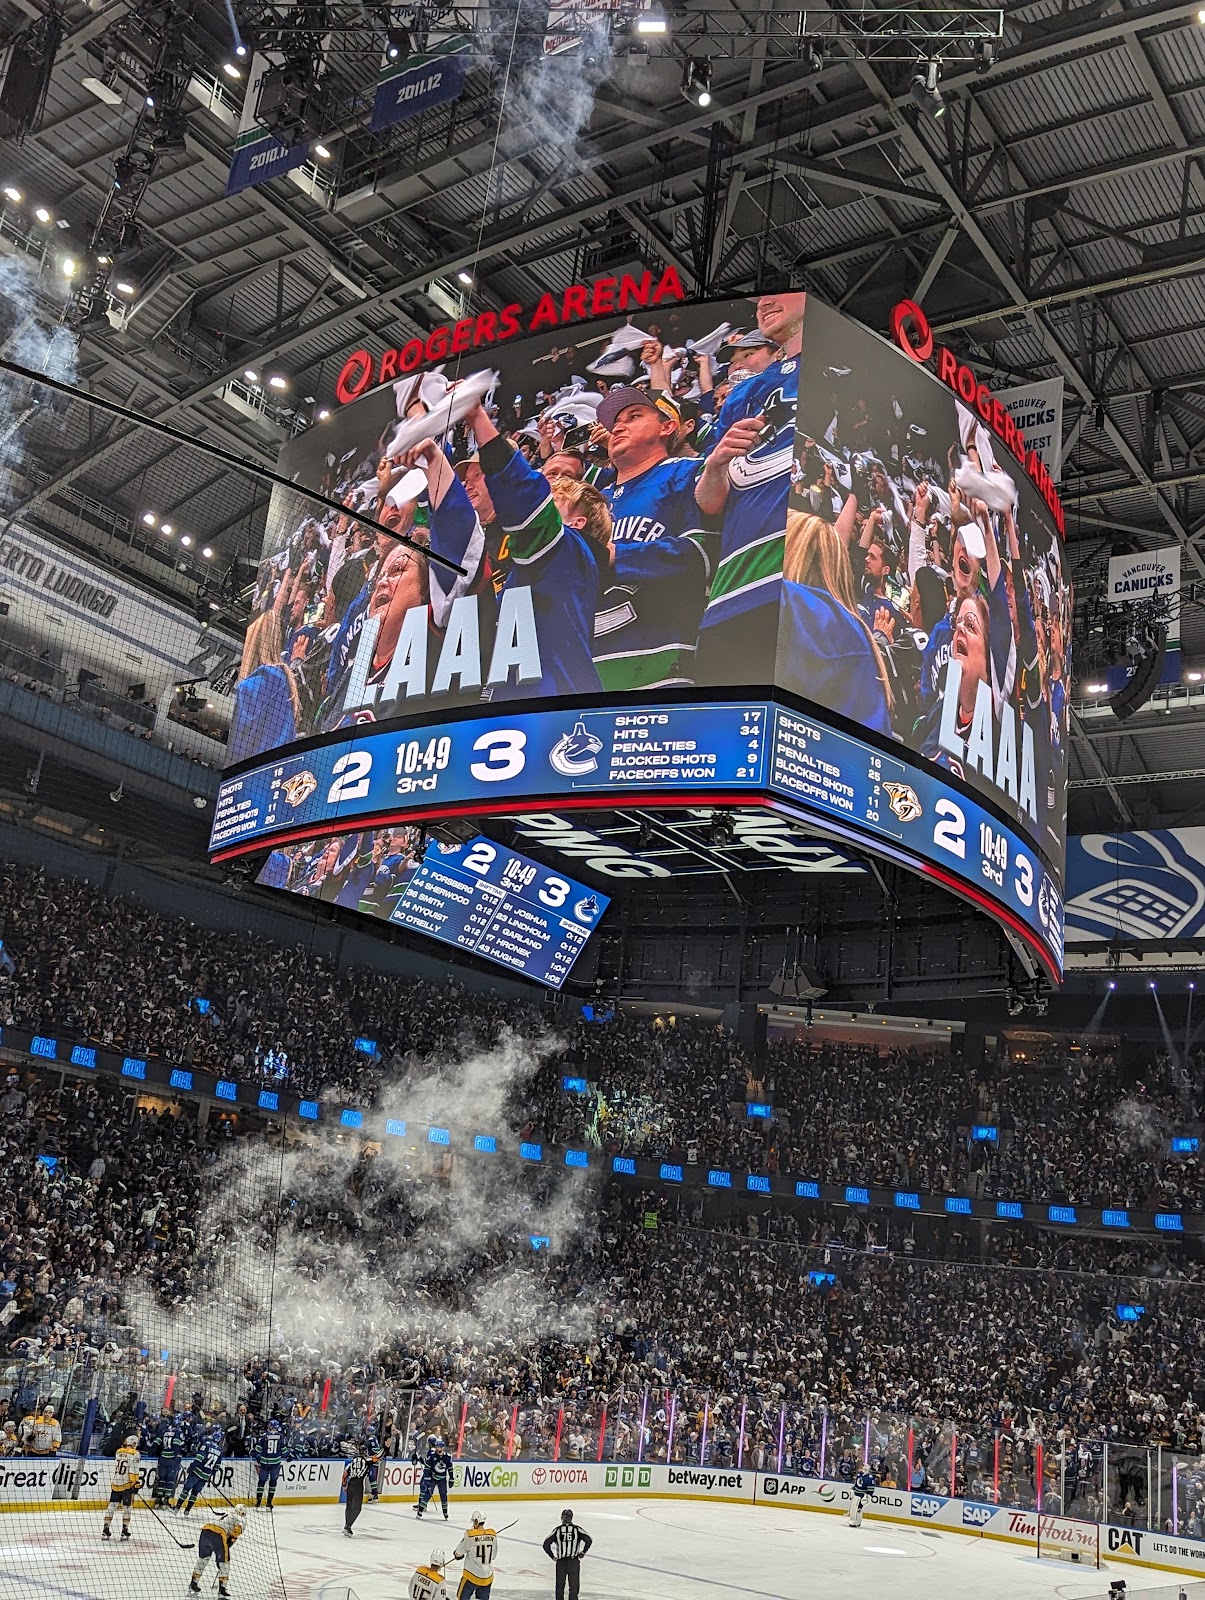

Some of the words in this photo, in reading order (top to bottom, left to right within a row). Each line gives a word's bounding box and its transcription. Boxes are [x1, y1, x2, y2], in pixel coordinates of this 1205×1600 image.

[396, 73, 442, 104] 2011.12
[379, 303, 522, 384] ROGERS
[529, 266, 685, 331] ARENA
[937, 347, 1026, 464] ROGERS
[1003, 399, 1046, 413] NCOUVER
[1012, 409, 1055, 429] UCKS
[612, 516, 665, 542] UVER
[1122, 564, 1166, 579] VANCOUVER
[43, 566, 118, 618] LUONGO
[1115, 573, 1173, 594] CANUCKS
[615, 714, 669, 726] SHOTS
[742, 712, 761, 722] 17
[614, 728, 648, 739] HITS
[740, 725, 760, 736] 34
[779, 716, 821, 741] SHOTS
[870, 756, 881, 768] 16
[938, 656, 1038, 824] LAAA
[612, 740, 696, 753] PENALTIES
[748, 739, 759, 750] 4
[778, 730, 806, 749] HITS
[868, 769, 881, 782] 25
[327, 751, 372, 804] 2
[396, 736, 451, 775] 10:49
[470, 730, 527, 781] 3
[610, 754, 670, 767] BLOCKED
[671, 753, 716, 765] SHOTS
[747, 753, 757, 764] 9
[777, 743, 840, 778] PENALTIES
[873, 784, 880, 795] 2
[220, 782, 243, 797] SHOTS
[274, 768, 284, 777] 16
[397, 774, 438, 794] 3rd
[609, 768, 679, 780] FACEOFFS
[680, 767, 715, 779] WON
[736, 767, 755, 778] 21
[776, 757, 821, 784] BLOCKED
[822, 776, 854, 798] SHOTS
[868, 796, 879, 808] 11
[219, 796, 234, 808] HITS
[271, 779, 281, 789] 25
[774, 772, 829, 801] FACEOFFS
[830, 792, 854, 812] WON
[866, 810, 879, 822] 20
[217, 800, 251, 819] PENALTIES
[273, 791, 279, 800] 2
[215, 814, 239, 831] BLOCKED
[239, 808, 259, 821] SHOTS
[268, 803, 277, 812] 11
[213, 824, 241, 842] FACEOFFS
[241, 820, 257, 831] WON
[265, 815, 276, 824] 20
[934, 798, 966, 860] 2
[979, 822, 1008, 870] 10:49
[1015, 854, 1033, 907] 3
[462, 842, 497, 875] 2
[502, 858, 537, 886] 10:49
[538, 877, 571, 907] 3
[981, 860, 1003, 887] 3rd
[421, 868, 428, 876] 9
[430, 871, 474, 895] FORSBERG
[482, 892, 500, 905] 0:12
[500, 876, 524, 894] 3rd
[413, 878, 424, 887] 44
[425, 882, 470, 906] SHERWOOD
[476, 903, 493, 915] 0:12
[401, 900, 410, 909] 14
[411, 904, 448, 923] NYQUIST
[463, 924, 481, 936] 0:12
[406, 889, 418, 898] 36
[419, 893, 445, 908] SMITH
[469, 913, 487, 926] 0:12
[394, 910, 405, 919] 90
[406, 914, 442, 933] O'REILLY
[457, 934, 475, 946] 0:12
[495, 912, 507, 922] 23
[508, 916, 551, 942] LINDHOLM
[560, 941, 578, 954] 0:12
[502, 901, 513, 910] 81
[513, 906, 548, 928] JOSHUA
[566, 932, 583, 944] 0:12
[485, 933, 494, 942] 17
[495, 938, 532, 958] HRONEK
[550, 962, 567, 975] 1:04
[492, 923, 499, 931] 8
[502, 928, 543, 950] GARLAND
[554, 952, 572, 964] 0:12
[478, 943, 490, 953] 43
[490, 948, 526, 969] HUGHES
[544, 972, 561, 984] 1:05
[31, 1037, 56, 1058] GOAL
[71, 1046, 95, 1067] GOAL
[122, 1058, 145, 1079] GOAL
[170, 1070, 192, 1089] GOAL
[216, 1081, 236, 1100] GOAL
[259, 1091, 278, 1110] GOAL
[299, 1101, 318, 1119] GOAL
[386, 1119, 406, 1136] GOAL
[429, 1128, 449, 1144] GOAL
[475, 1136, 496, 1152] GOAL
[520, 1143, 541, 1160] GOAL
[566, 1150, 588, 1168] GOAL
[614, 1158, 635, 1174] GOAL
[660, 1164, 682, 1181] GOAL
[709, 1171, 731, 1187] GOAL
[747, 1176, 770, 1192] GOAL
[796, 1182, 819, 1197] GOAL
[846, 1187, 869, 1203] GOAL
[896, 1193, 920, 1209] GOAL
[945, 1198, 971, 1213] GOAL
[997, 1202, 1023, 1218] GOAL
[267, 1440, 278, 1454] 91
[279, 1464, 331, 1482] ASKEN
[463, 1466, 518, 1487] NexGen
[549, 1469, 588, 1483] TOYOTA
[668, 1468, 743, 1489] betway.net
[912, 1498, 940, 1515] SAP
[963, 1506, 991, 1523] SAP
[1008, 1512, 1036, 1535] Tim
[562, 1532, 572, 1542] 76
[1108, 1528, 1143, 1556] CAT
[476, 1545, 492, 1564] 47
[1154, 1543, 1168, 1552] LET'S
[1178, 1547, 1189, 1556] THE
